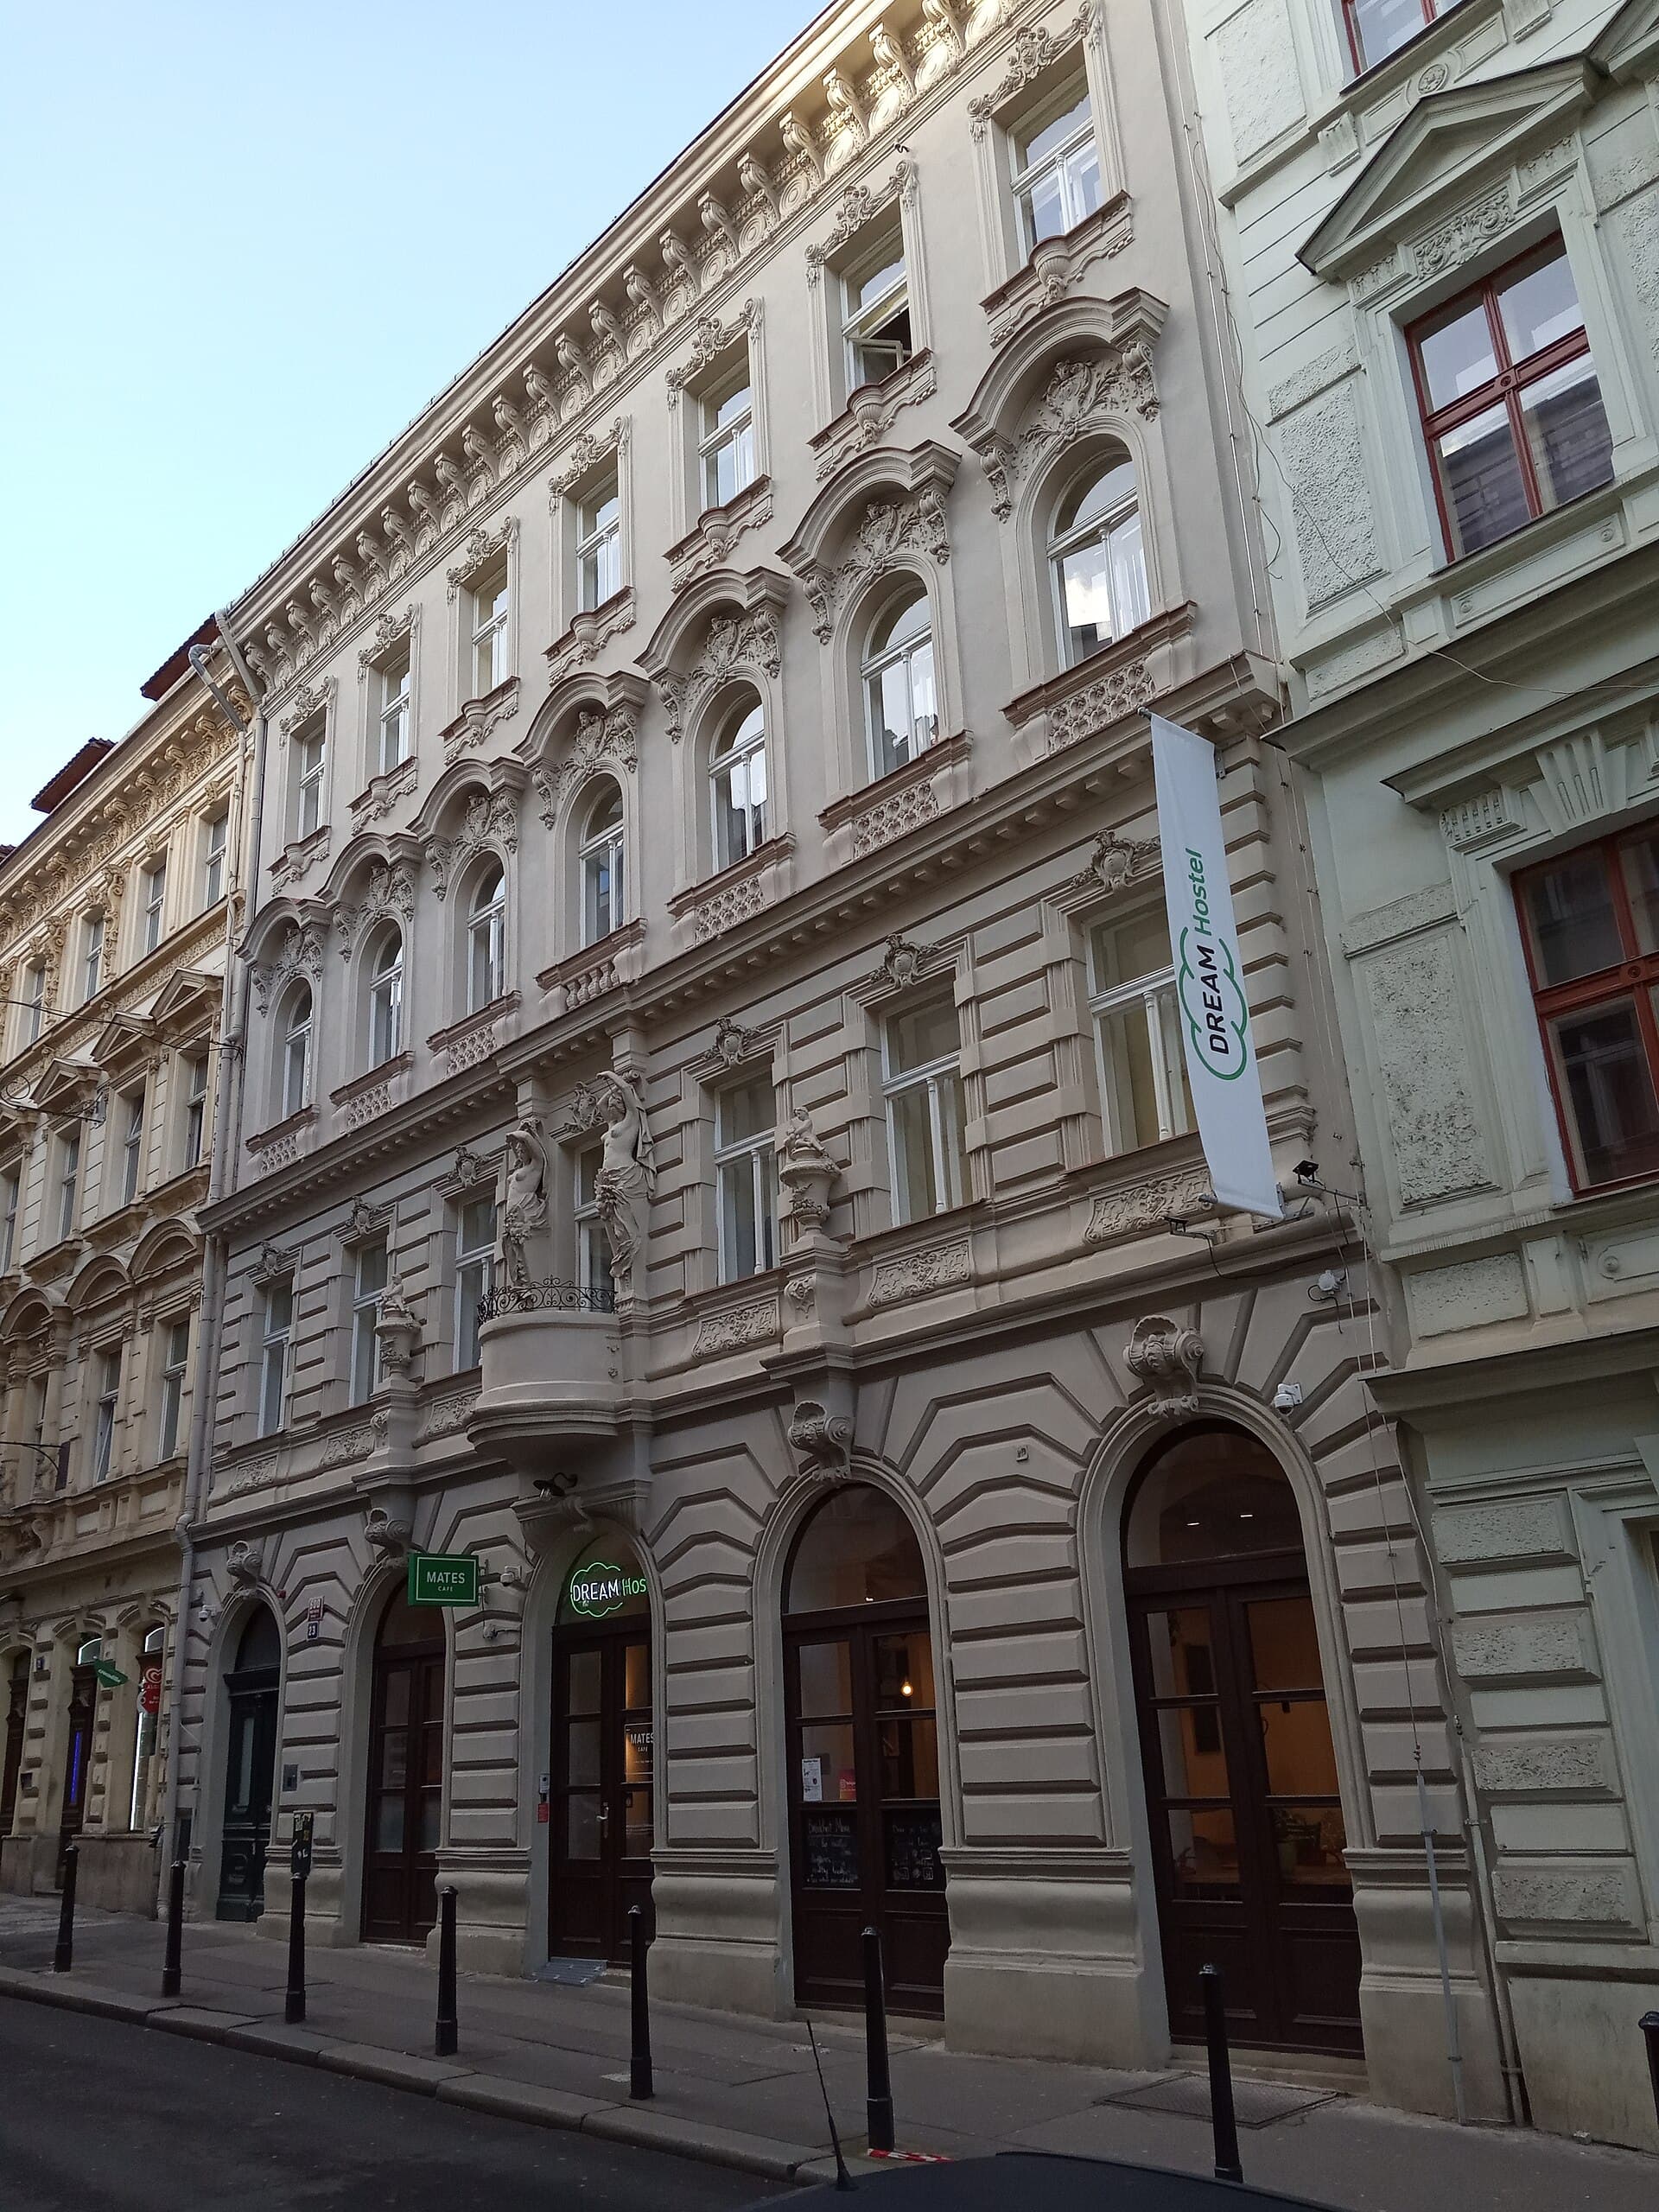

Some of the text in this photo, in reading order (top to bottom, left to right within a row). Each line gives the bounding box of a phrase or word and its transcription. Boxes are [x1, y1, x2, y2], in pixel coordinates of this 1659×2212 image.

[1185, 848, 1230, 1055] DREAM Hostel
[427, 1571, 466, 1584] MATES
[572, 1579, 620, 1602] DREAM
[308, 1625, 316, 1637] 23
[630, 1732, 654, 1745] MATES
